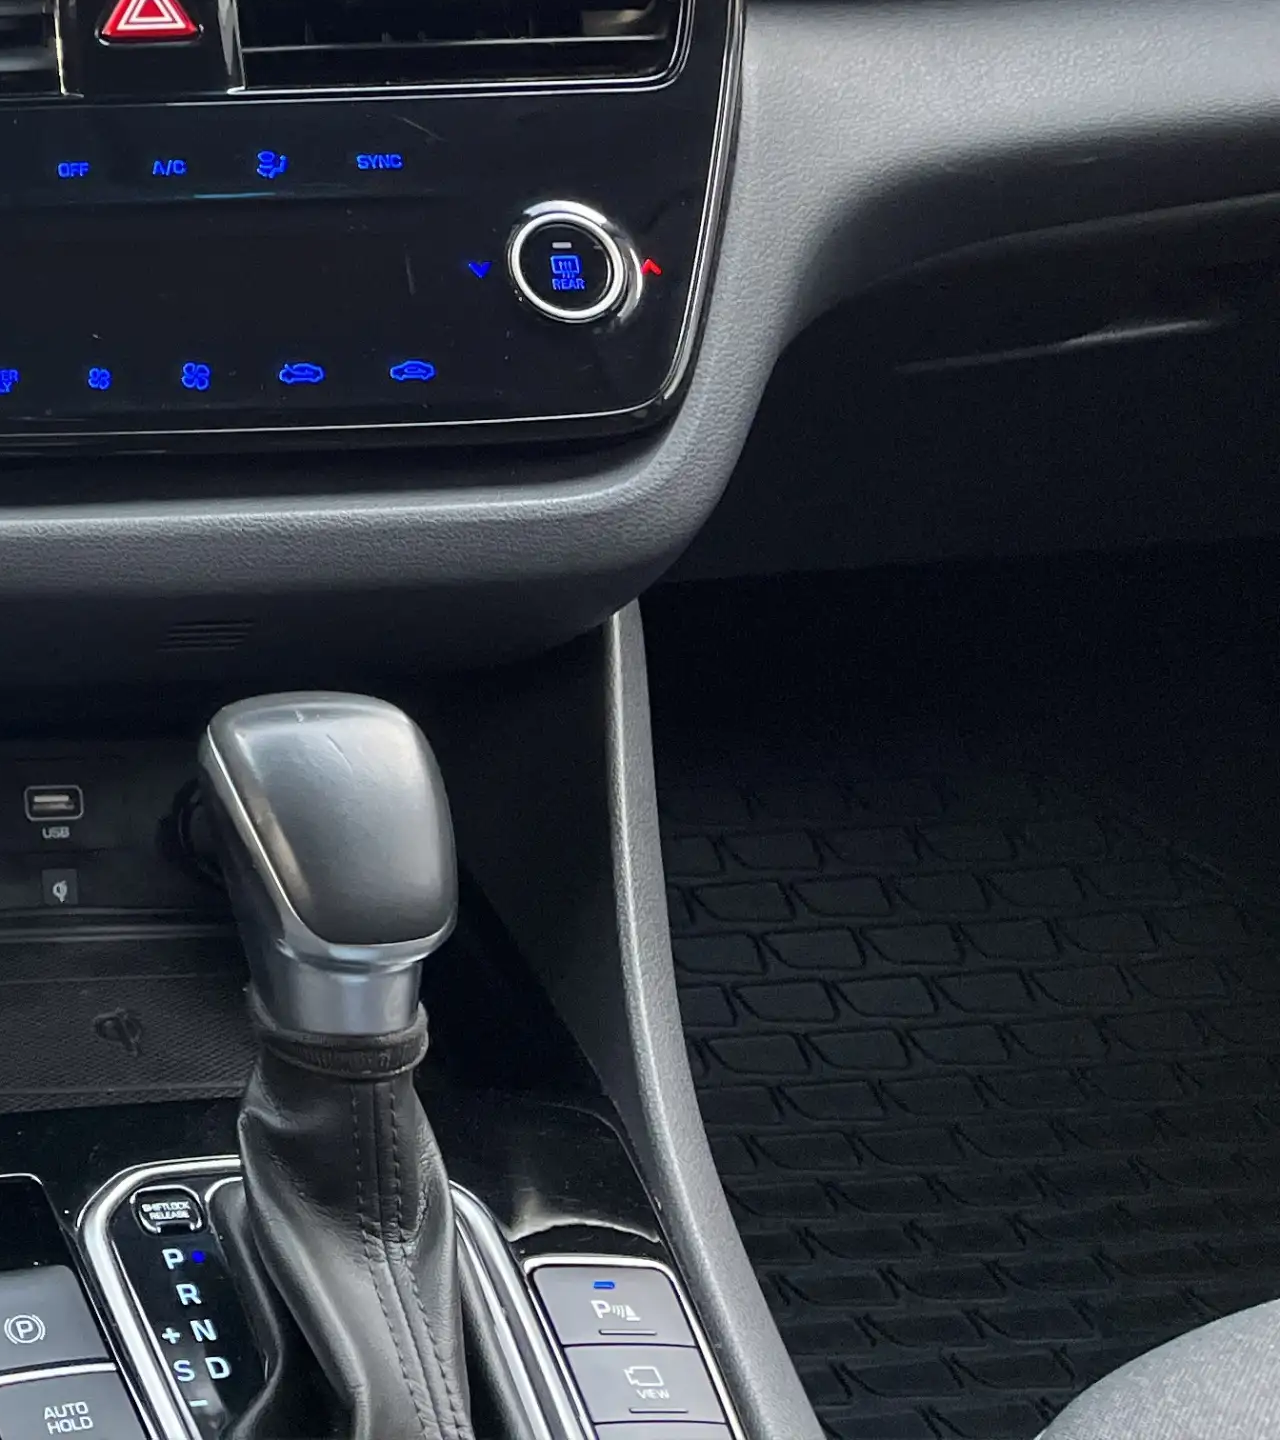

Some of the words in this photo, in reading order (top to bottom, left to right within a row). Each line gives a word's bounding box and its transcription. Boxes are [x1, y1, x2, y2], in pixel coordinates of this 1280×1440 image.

[57, 162, 89, 178] OFF
[152, 159, 187, 176] A/C
[356, 153, 403, 170] SYNC
[551, 277, 585, 291] REAR
[42, 826, 70, 839] USB
[161, 1248, 185, 1269] P
[175, 1283, 202, 1306] R
[189, 1318, 218, 1342] N
[172, 1359, 196, 1382] S
[204, 1356, 232, 1380] D
[636, 1388, 670, 1400] VIEW
[43, 1401, 89, 1420] AUTO
[46, 1415, 94, 1434] HOLD
